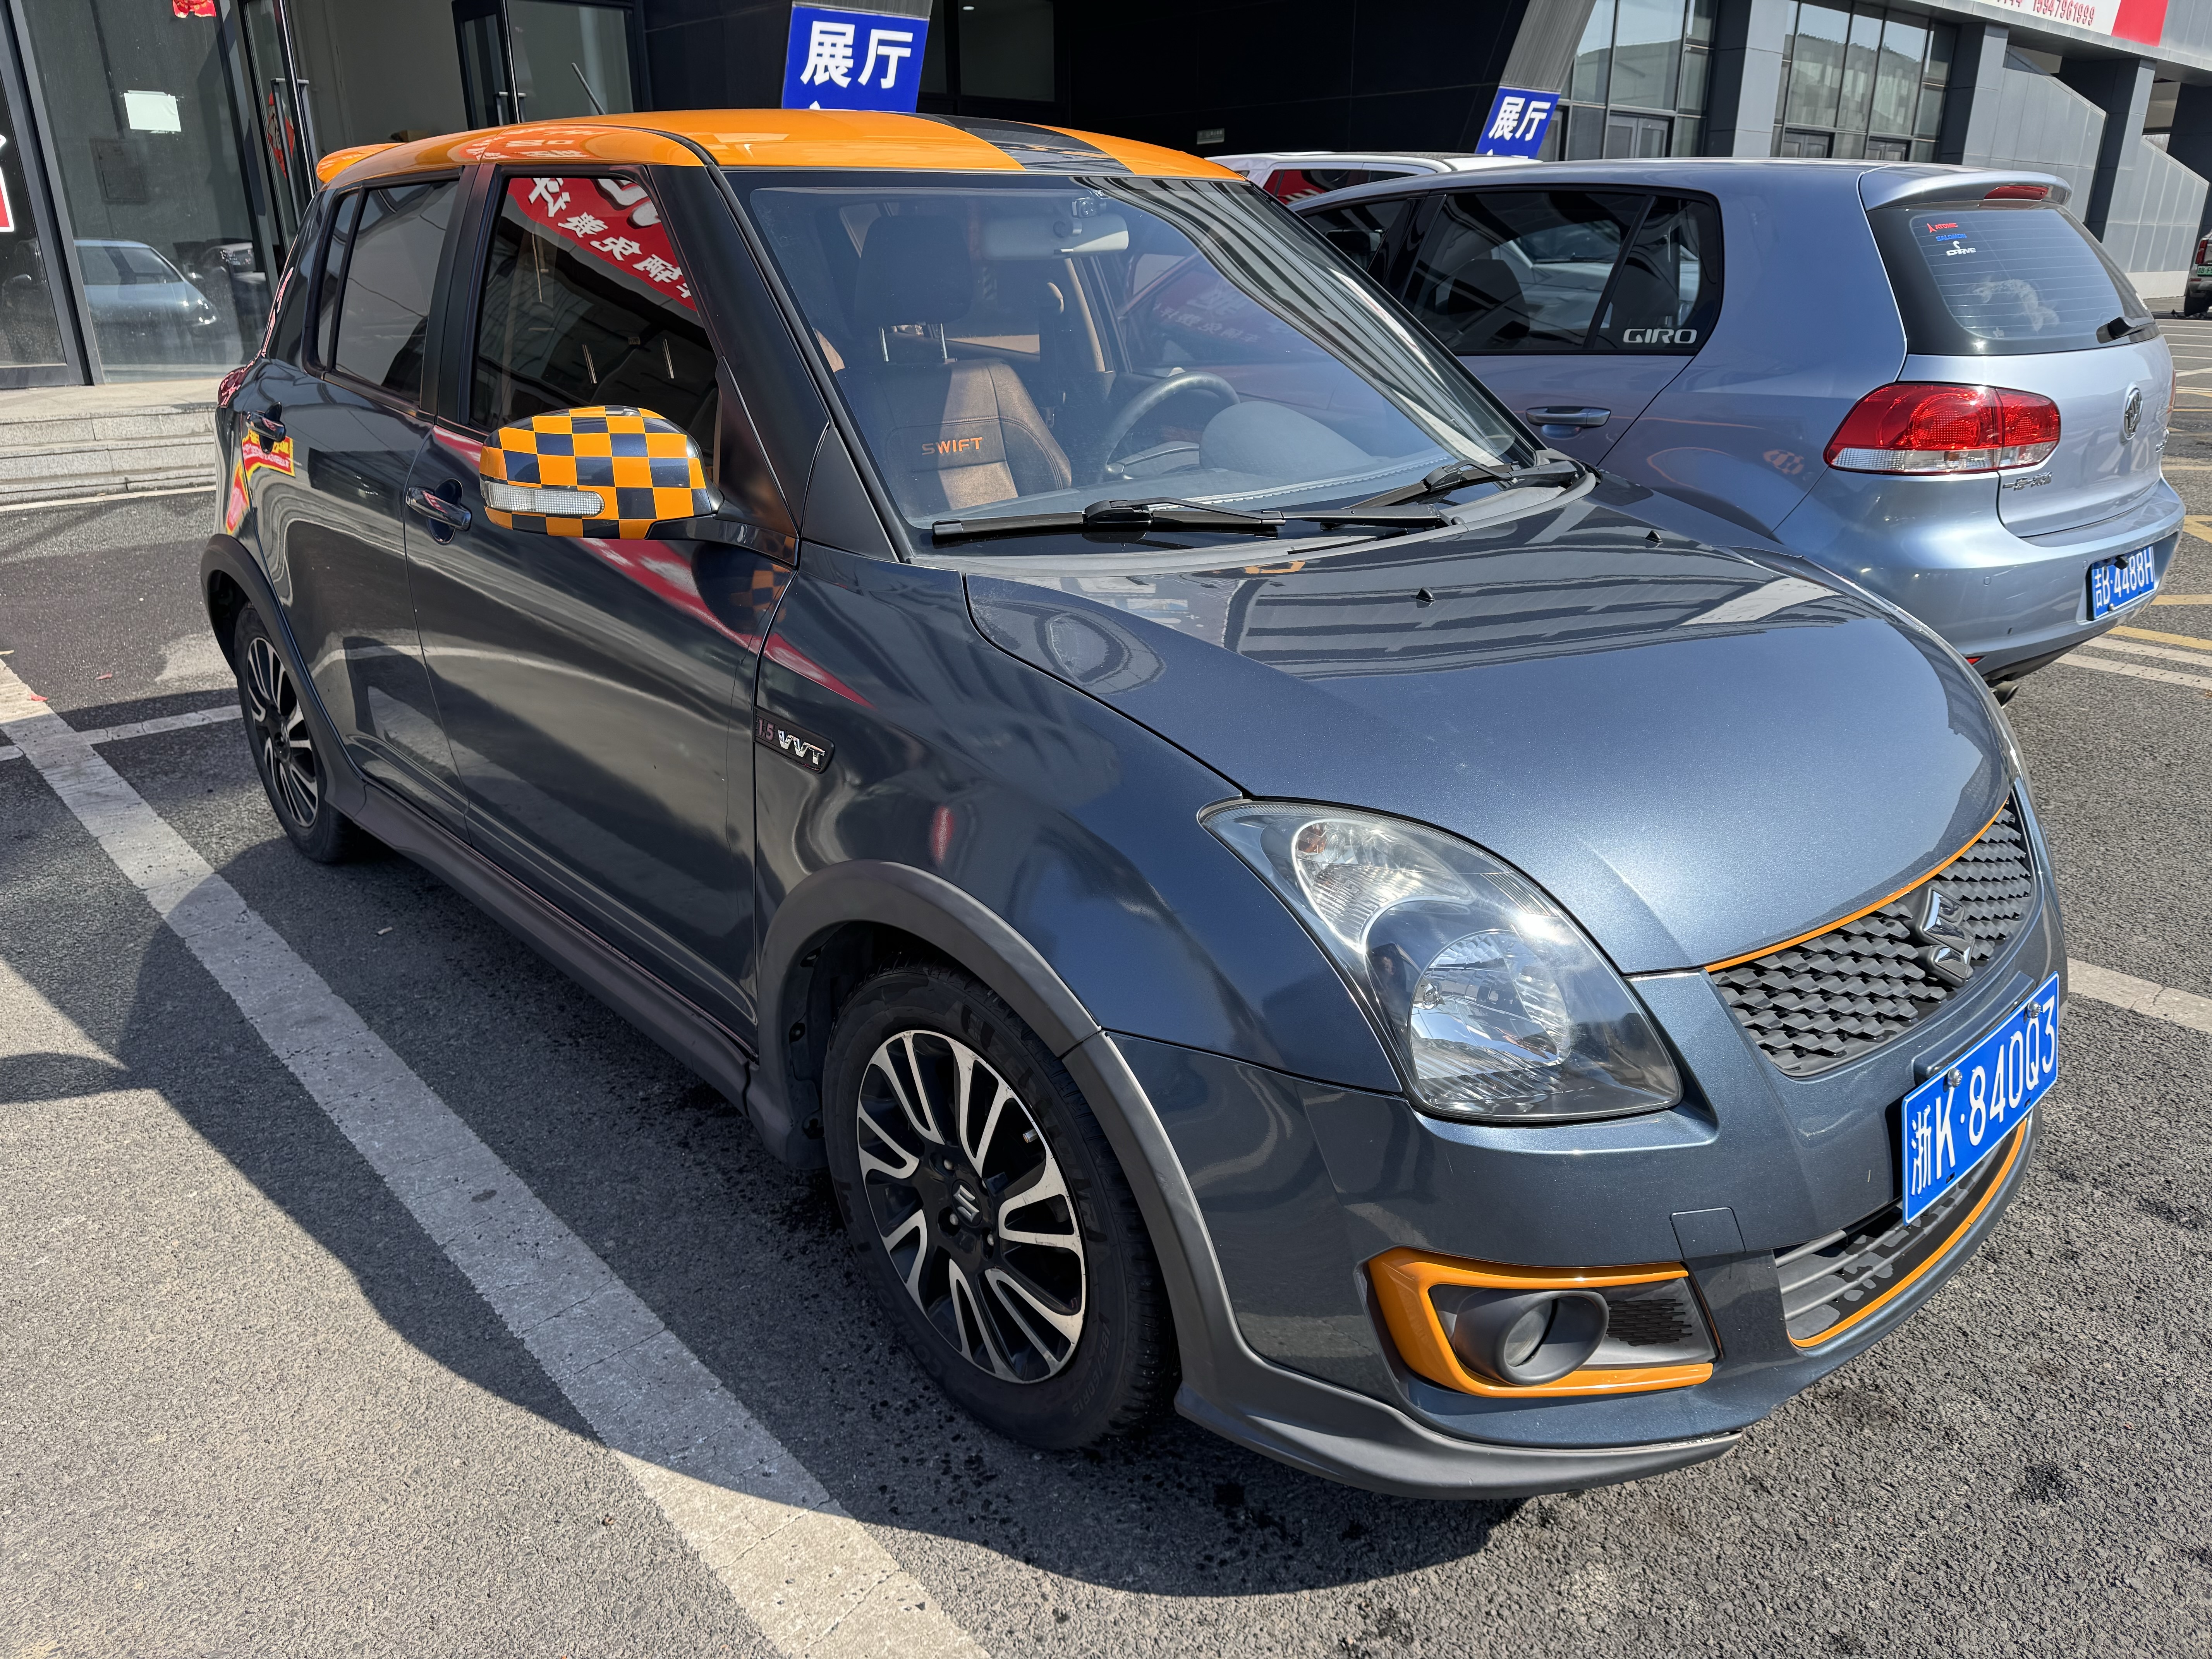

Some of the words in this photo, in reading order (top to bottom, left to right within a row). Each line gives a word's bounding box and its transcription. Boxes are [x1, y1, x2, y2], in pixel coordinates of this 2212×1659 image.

[800, 21, 913, 89] 展厅
[1488, 96, 1551, 141] 展厅
[1936, 233, 1967, 241] SALOMON
[1623, 328, 1697, 344] GIRO
[922, 437, 983, 455] SWIFT
[758, 718, 775, 741] 1.5
[778, 726, 826, 765] VVT
[1911, 995, 2055, 1195] 浙K·840Q3
[1072, 1322, 1111, 1417] 185/60R15
